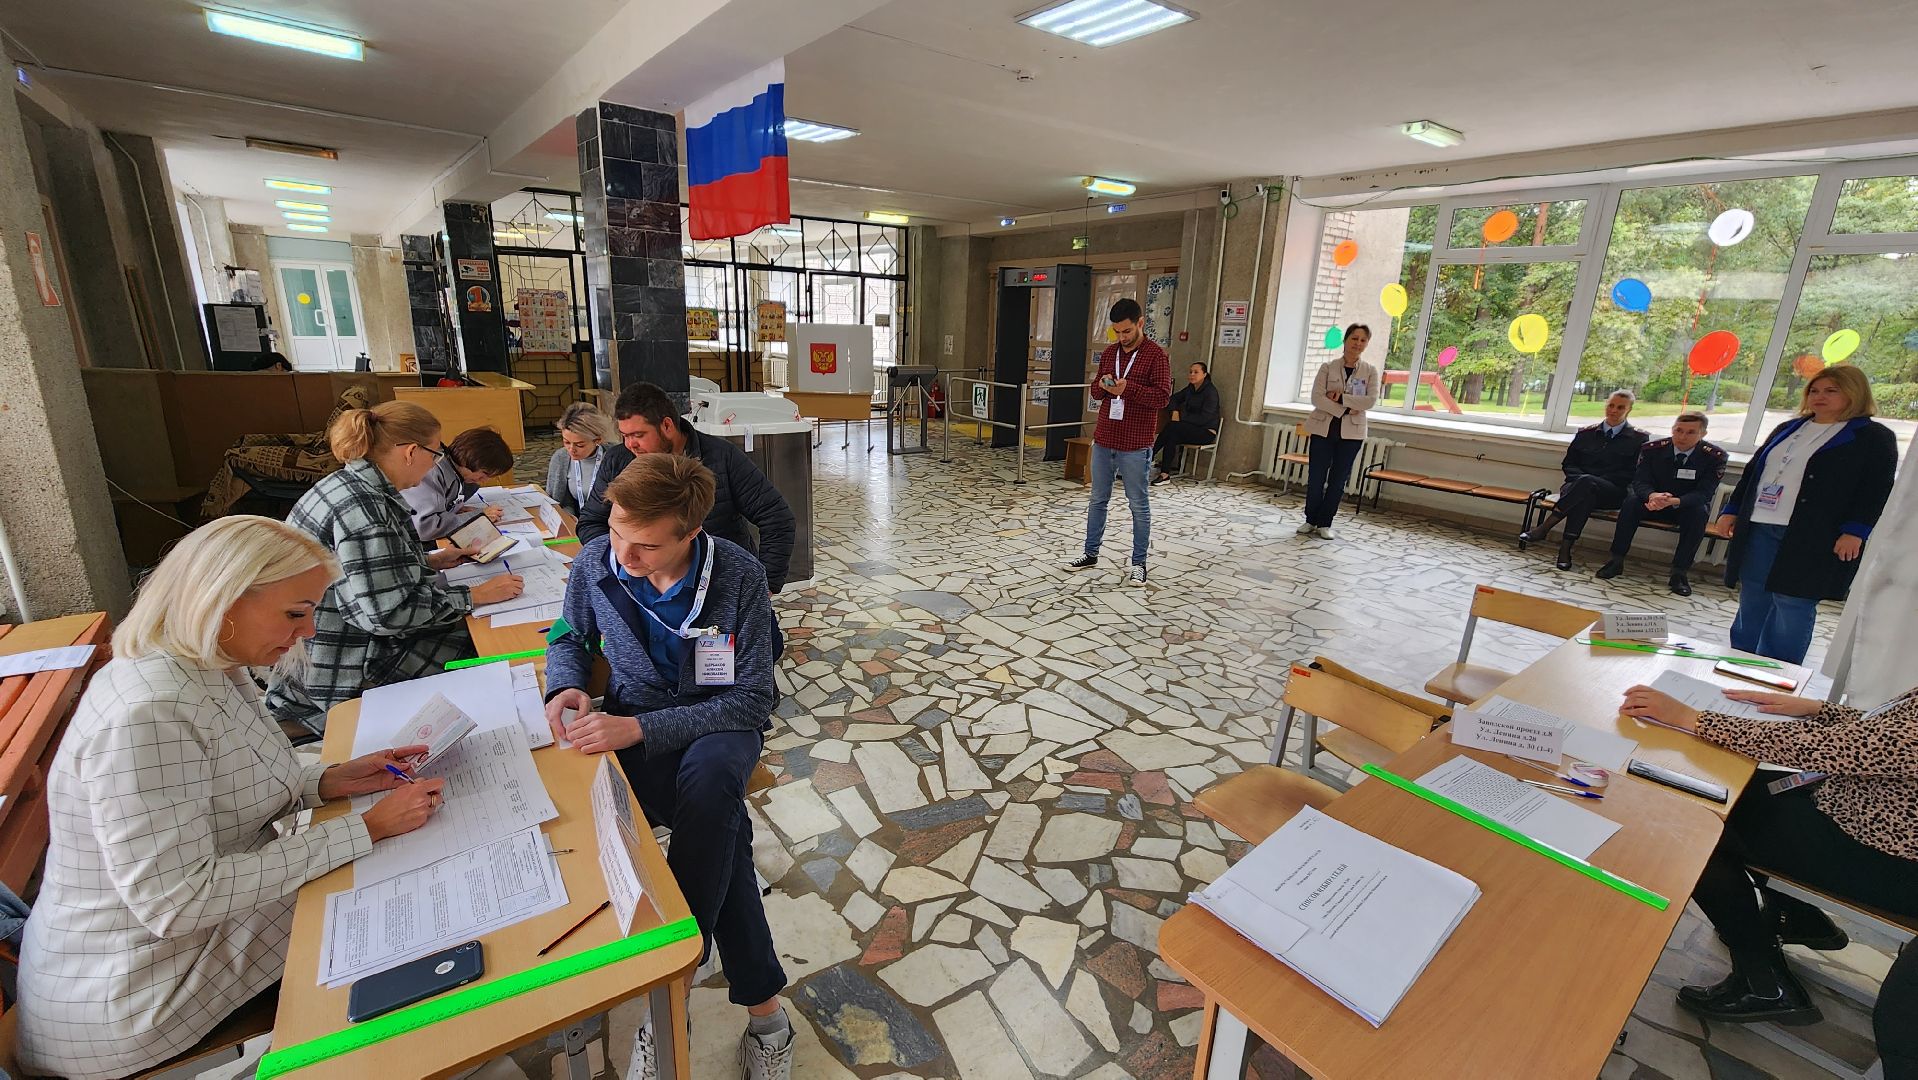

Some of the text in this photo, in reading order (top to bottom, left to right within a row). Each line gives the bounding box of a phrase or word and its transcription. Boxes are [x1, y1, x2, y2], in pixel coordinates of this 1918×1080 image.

[1477, 718, 1514, 730] Заводской
[1516, 725, 1541, 736] проезд
[1480, 726, 1492, 734] Ул.
[1492, 729, 1521, 740] Ленина
[1476, 733, 1488, 741] Ул.
[1488, 736, 1517, 746] Ленина
[1526, 743, 1535, 751] 30
[1298, 891, 1320, 911] СПИСОК
